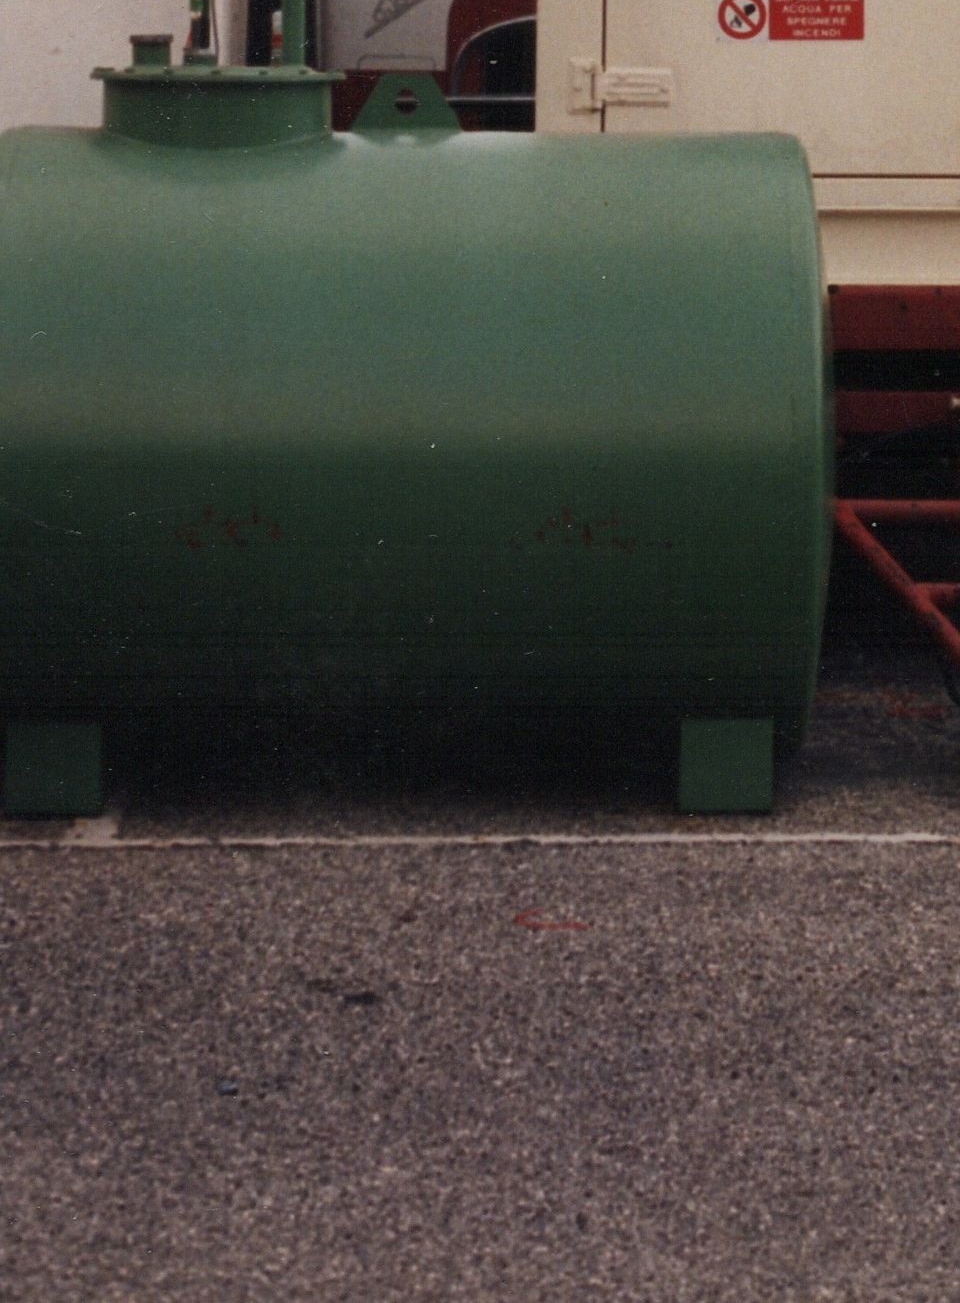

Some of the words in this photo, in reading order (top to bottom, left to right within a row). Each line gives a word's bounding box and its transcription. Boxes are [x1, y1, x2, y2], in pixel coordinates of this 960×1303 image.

[782, 5, 821, 14] ACQUA
[829, 5, 852, 14] PER
[787, 17, 847, 26] SPEGNERE
